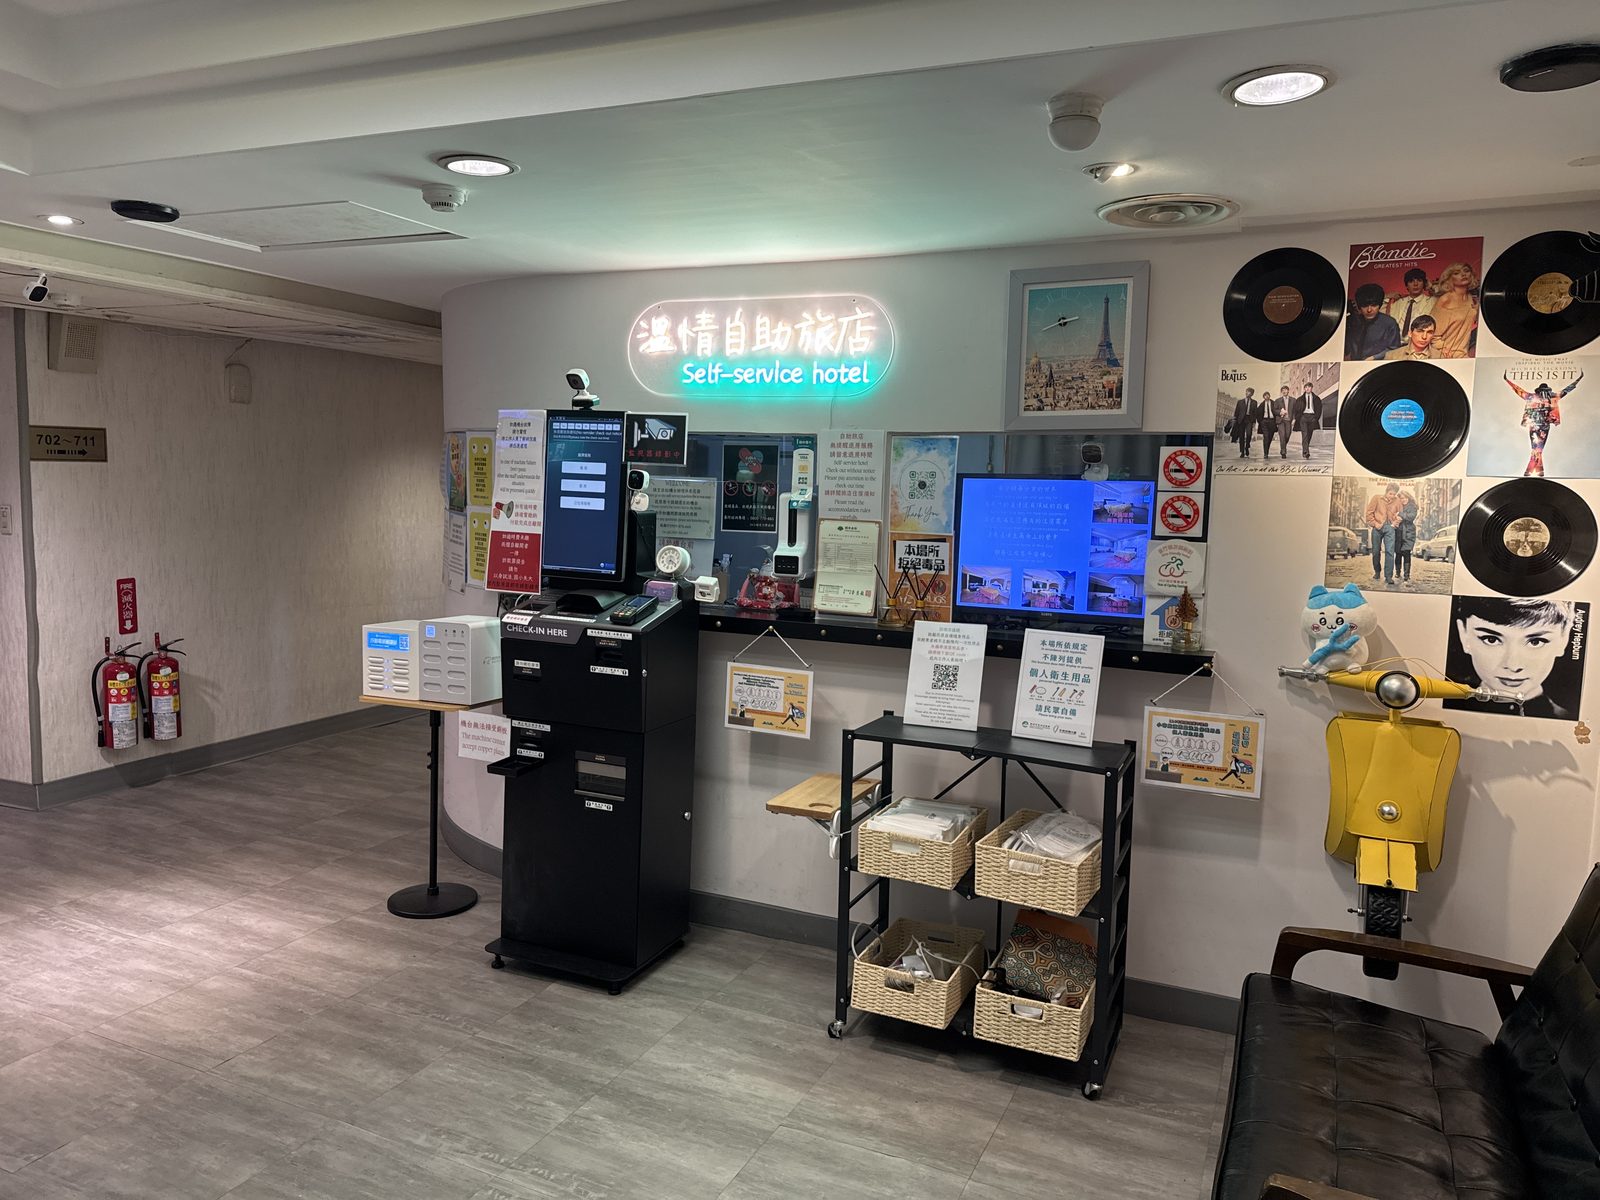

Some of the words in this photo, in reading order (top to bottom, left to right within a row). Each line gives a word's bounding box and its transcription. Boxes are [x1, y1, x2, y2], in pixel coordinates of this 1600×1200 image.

[1350, 242, 1436, 270] Blondie
[636, 308, 874, 358] 溫情自助旅店
[682, 361, 803, 385] Self-service
[812, 361, 871, 385] hotel
[1221, 370, 1247, 382] BEATLES
[1510, 371, 1543, 380] THIS
[1547, 370, 1558, 380] IS
[1563, 370, 1577, 380] IT
[1280, 465, 1296, 474] BBC
[1321, 466, 1329, 474] 2
[904, 544, 940, 557] 本場所
[898, 557, 945, 571] 拒絕毒品
[122, 596, 133, 619] 滅火器
[1572, 608, 1586, 632] Audrey
[506, 624, 545, 636] CHECK-IN
[547, 627, 568, 637] HERE
[1040, 640, 1088, 651] 本場所依規定
[1572, 632, 1584, 660] Hepburn
[1042, 654, 1082, 664] 不陳列提供
[1029, 668, 1091, 683] 個人衛生用品
[1035, 704, 1077, 717] 請民眾自備
